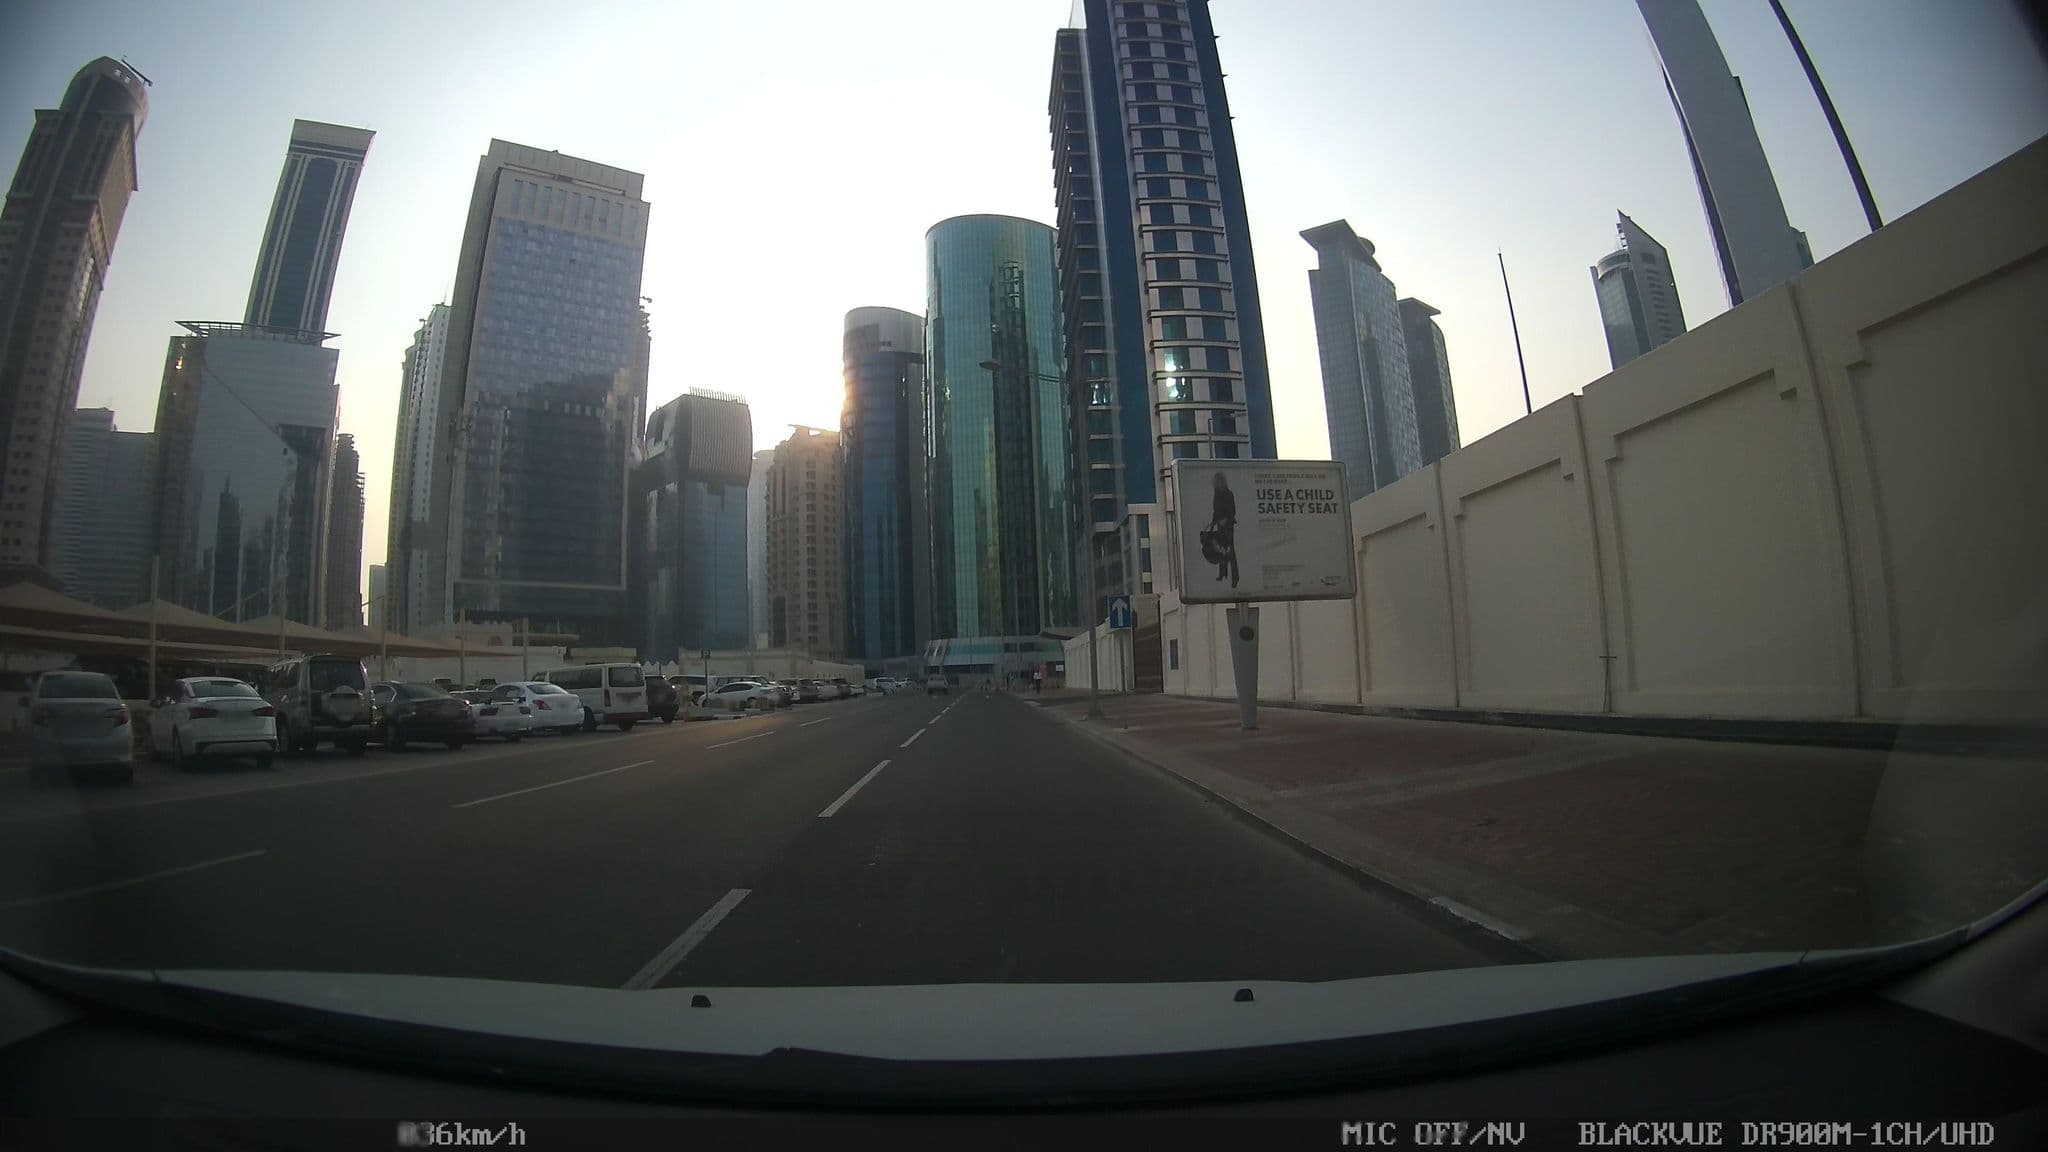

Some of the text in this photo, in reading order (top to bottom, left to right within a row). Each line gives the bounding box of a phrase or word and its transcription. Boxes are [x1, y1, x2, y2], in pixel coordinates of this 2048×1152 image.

[1256, 489, 1335, 500] USE A CHILD
[1258, 502, 1338, 514] SAFETY SEAT
